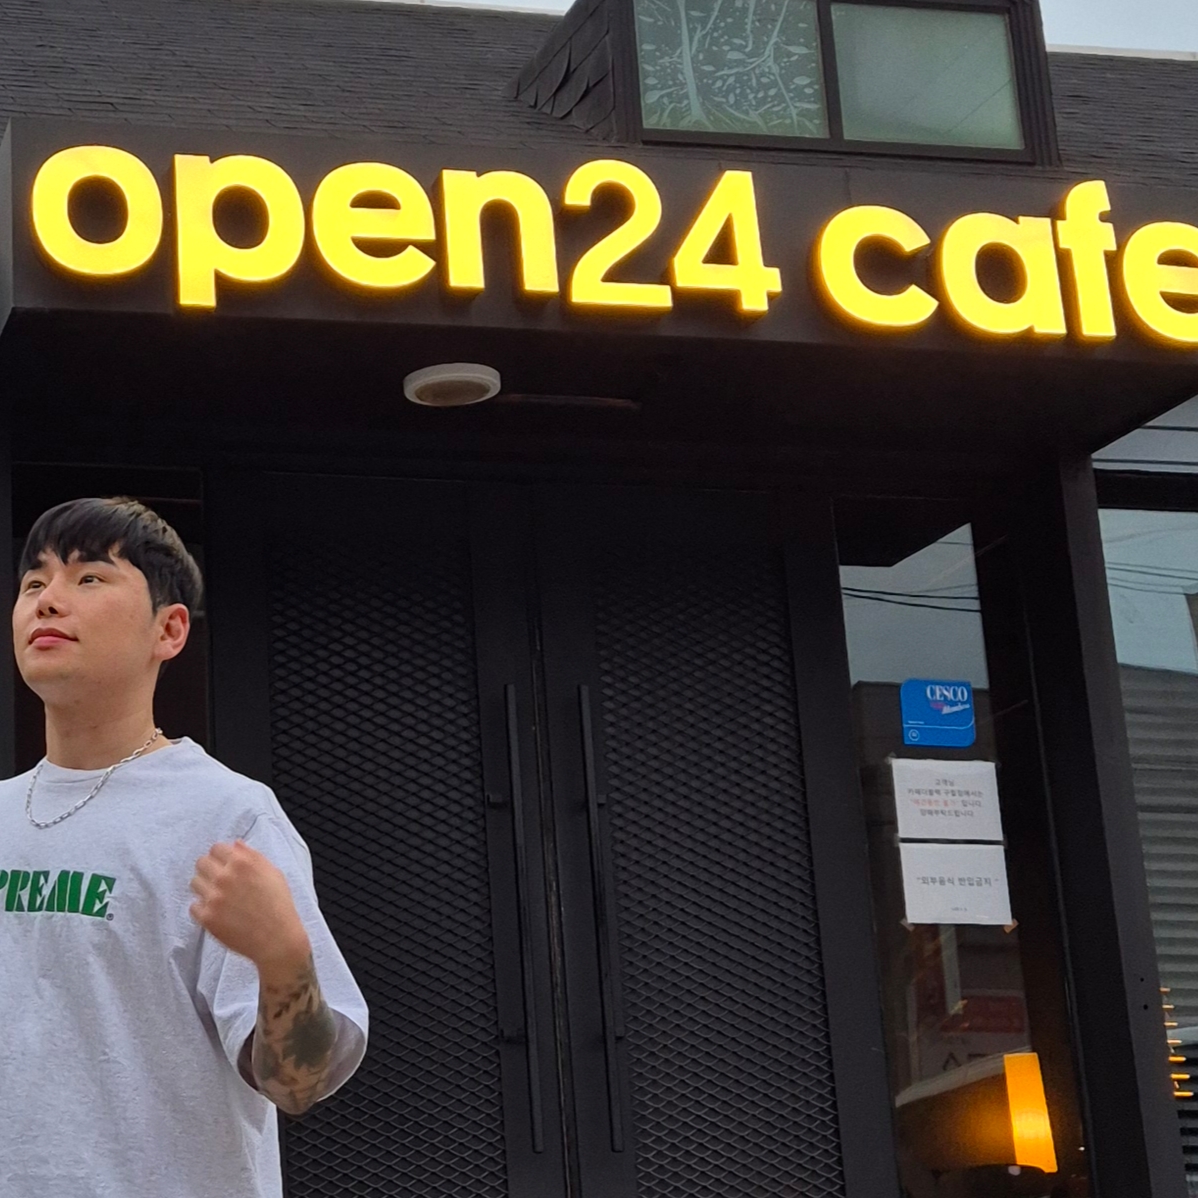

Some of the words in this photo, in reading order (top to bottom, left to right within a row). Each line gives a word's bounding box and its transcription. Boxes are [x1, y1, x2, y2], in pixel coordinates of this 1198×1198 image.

[31, 145, 782, 312] open24
[817, 180, 1198, 344] cafe
[926, 685, 968, 702] CESCO
